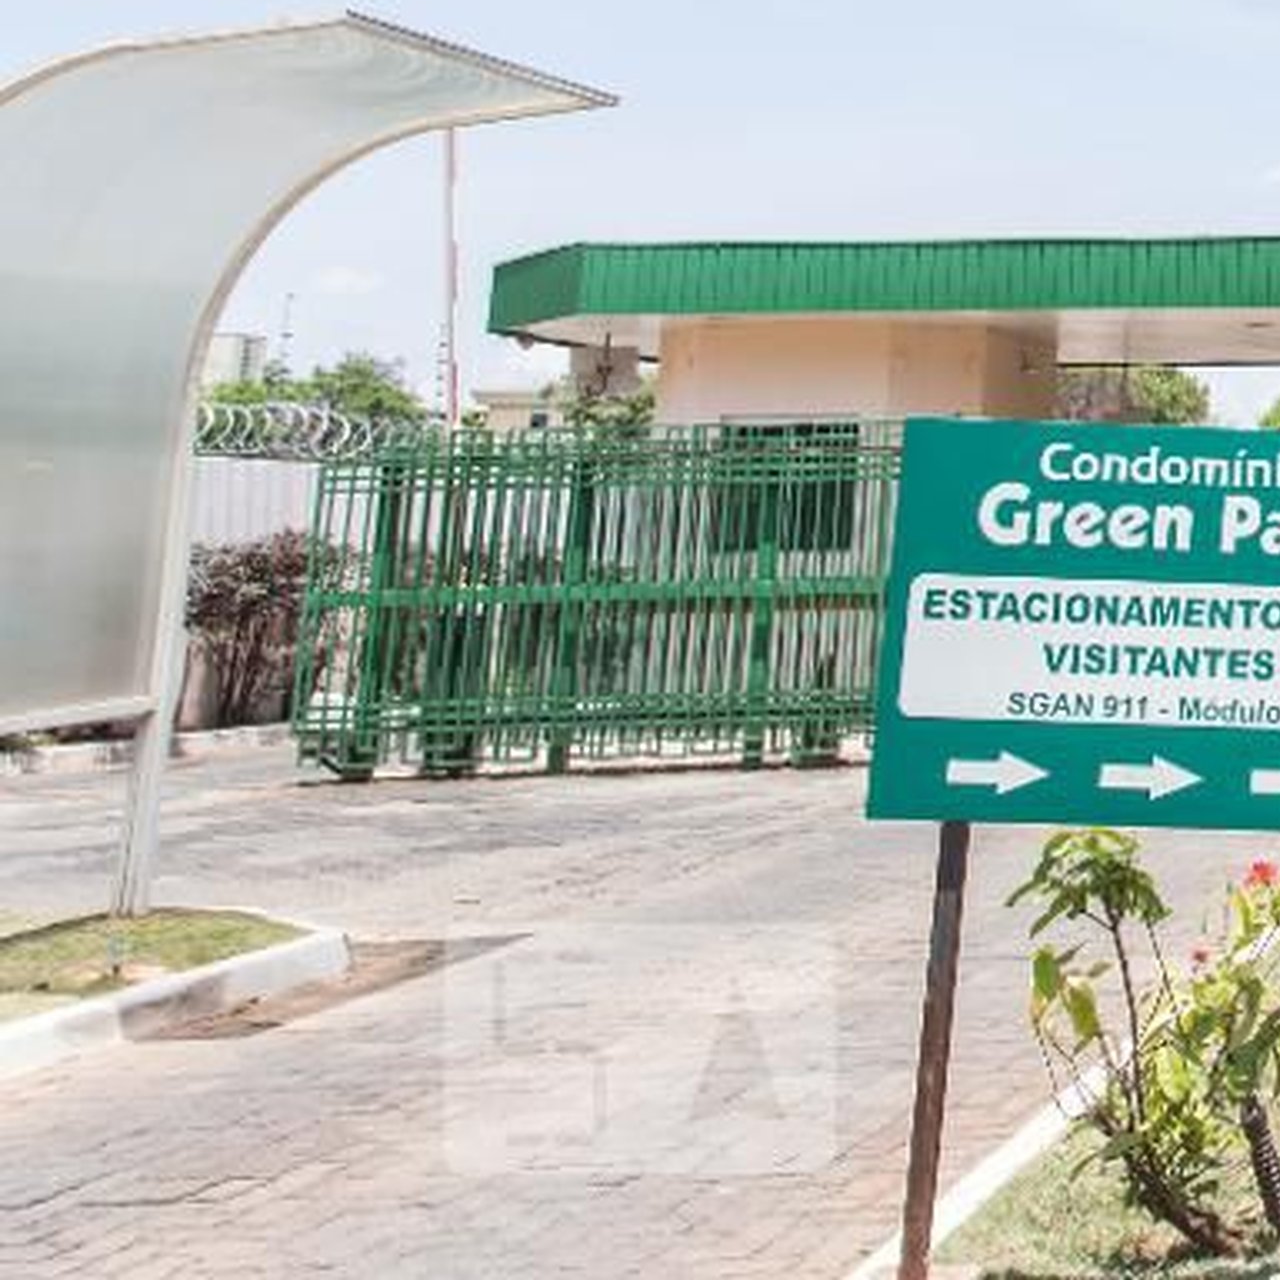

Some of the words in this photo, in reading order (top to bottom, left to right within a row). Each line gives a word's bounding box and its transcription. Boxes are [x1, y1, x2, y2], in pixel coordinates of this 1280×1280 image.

[978, 482, 1194, 552] Green
[1042, 642, 1276, 681] VISITANTES
[1006, 691, 1095, 718] SGAN
[1102, 694, 1150, 720] 911
